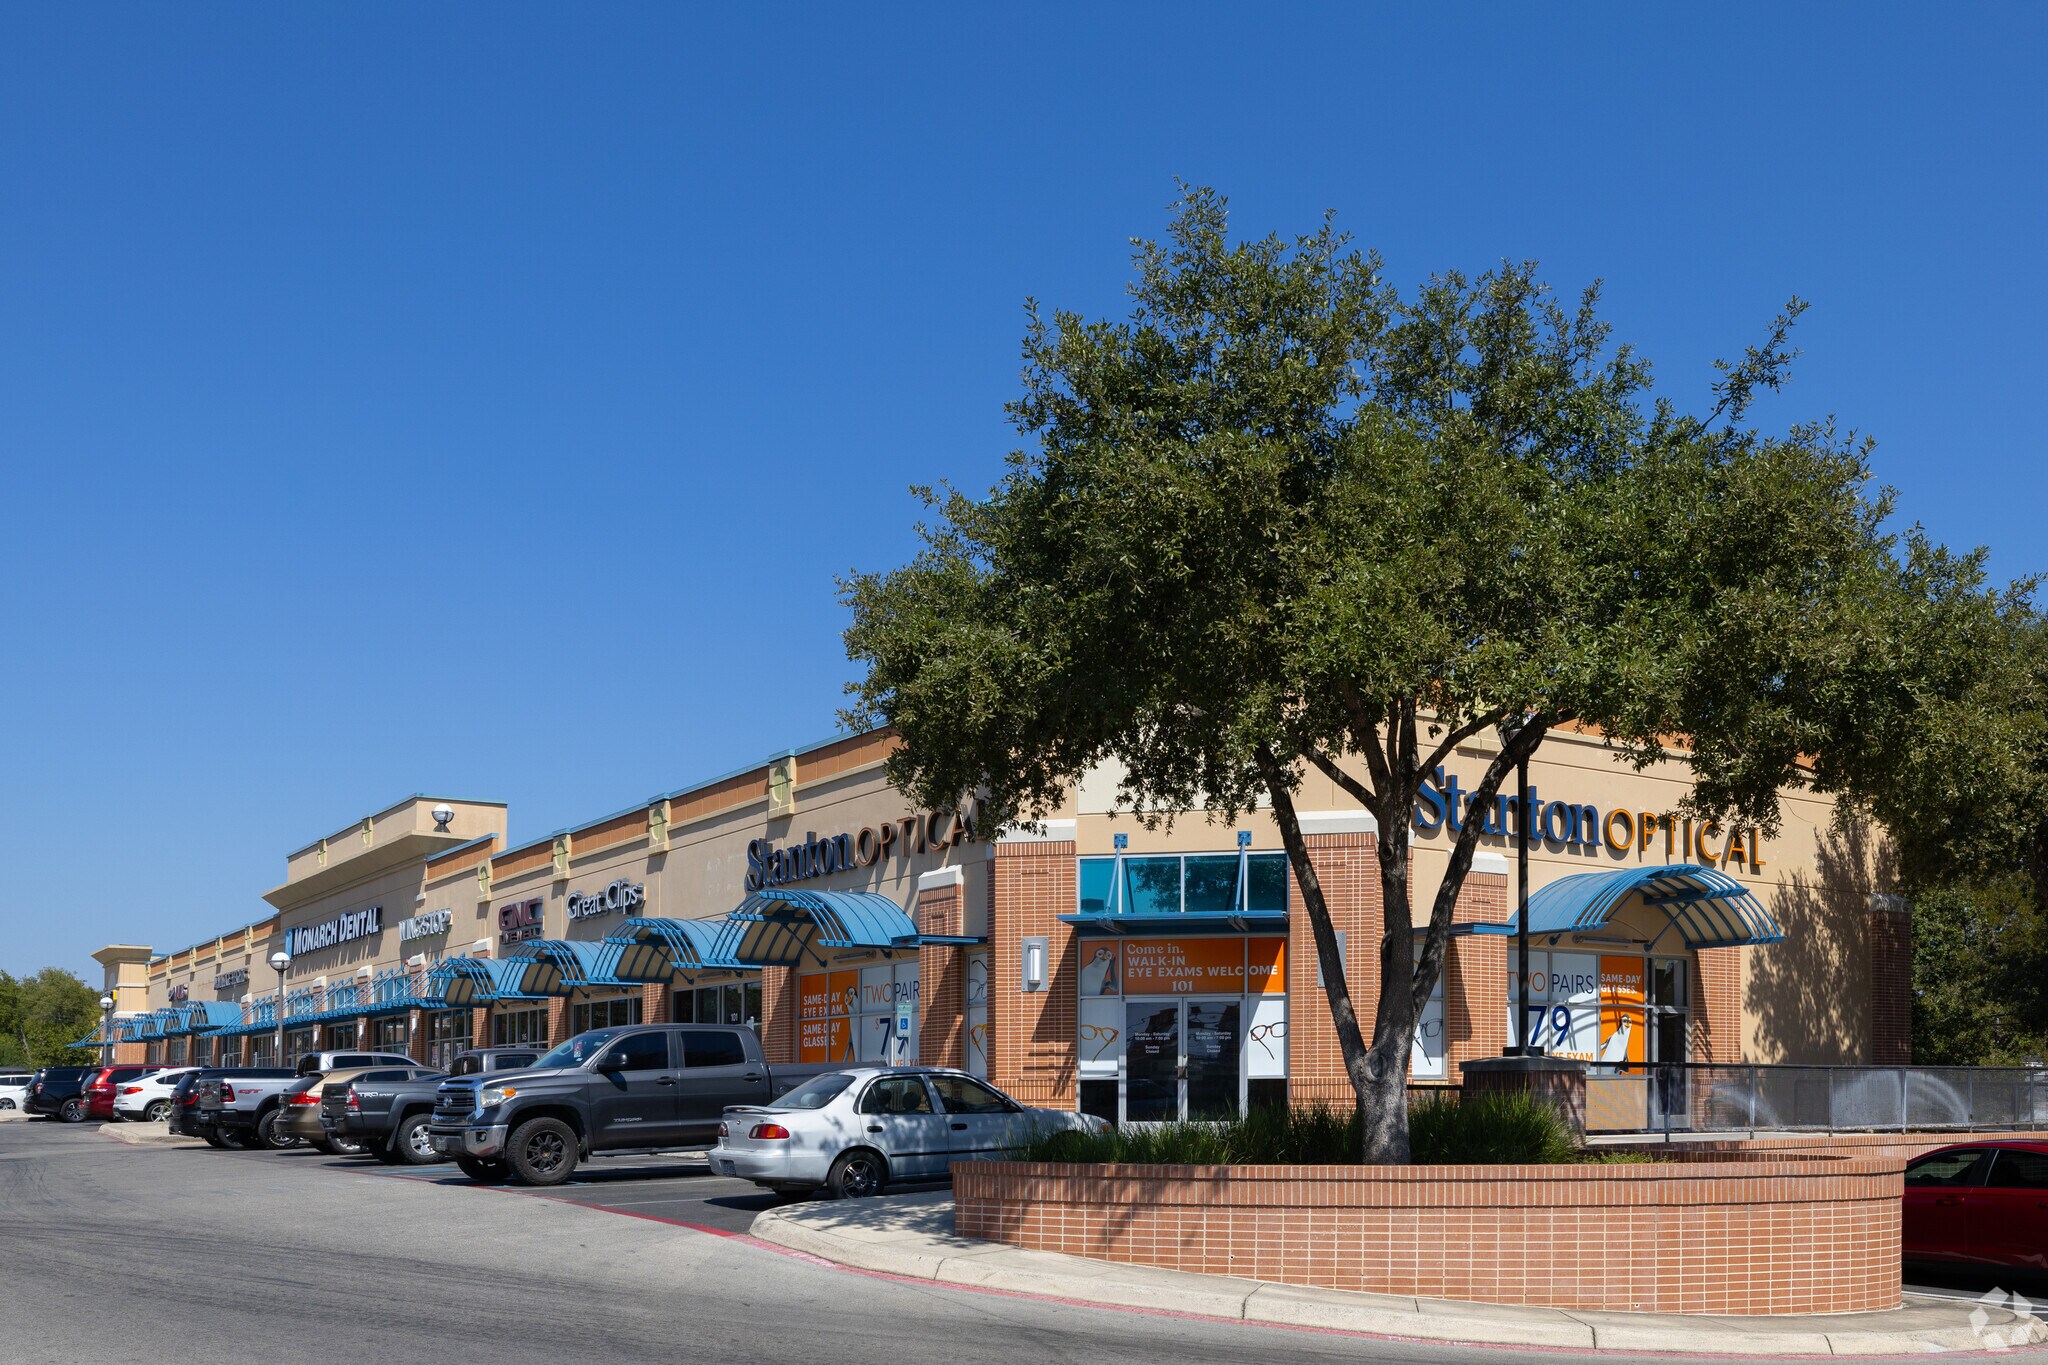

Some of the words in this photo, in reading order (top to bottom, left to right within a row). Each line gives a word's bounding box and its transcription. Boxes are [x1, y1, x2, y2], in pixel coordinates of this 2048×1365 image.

[1608, 808, 1767, 866] OPTICAL
[746, 831, 856, 892] Stanton
[566, 892, 602, 919] Great
[606, 881, 640, 915] Clips
[498, 898, 541, 931] GNC
[293, 919, 338, 956] MONARCH
[339, 907, 379, 943] DENTAL
[1127, 943, 1164, 954] Come
[1167, 943, 1184, 954] in.
[1128, 956, 1186, 967] WALK-IN
[1128, 967, 1152, 977] EYE
[1158, 966, 1202, 977] EXAMS
[1207, 965, 1278, 976] WELCOME
[1552, 974, 1594, 994] PAIRS
[1601, 974, 1641, 983] SAME-DAY
[1172, 980, 1193, 992] 101
[1601, 984, 1638, 994] GLASSES.
[803, 992, 841, 1006] SAME-DAY
[803, 1006, 817, 1018] EYE
[819, 1004, 844, 1017] EXAM.
[803, 1022, 841, 1035] SAME-DAY
[1528, 1005, 1571, 1047] 79
